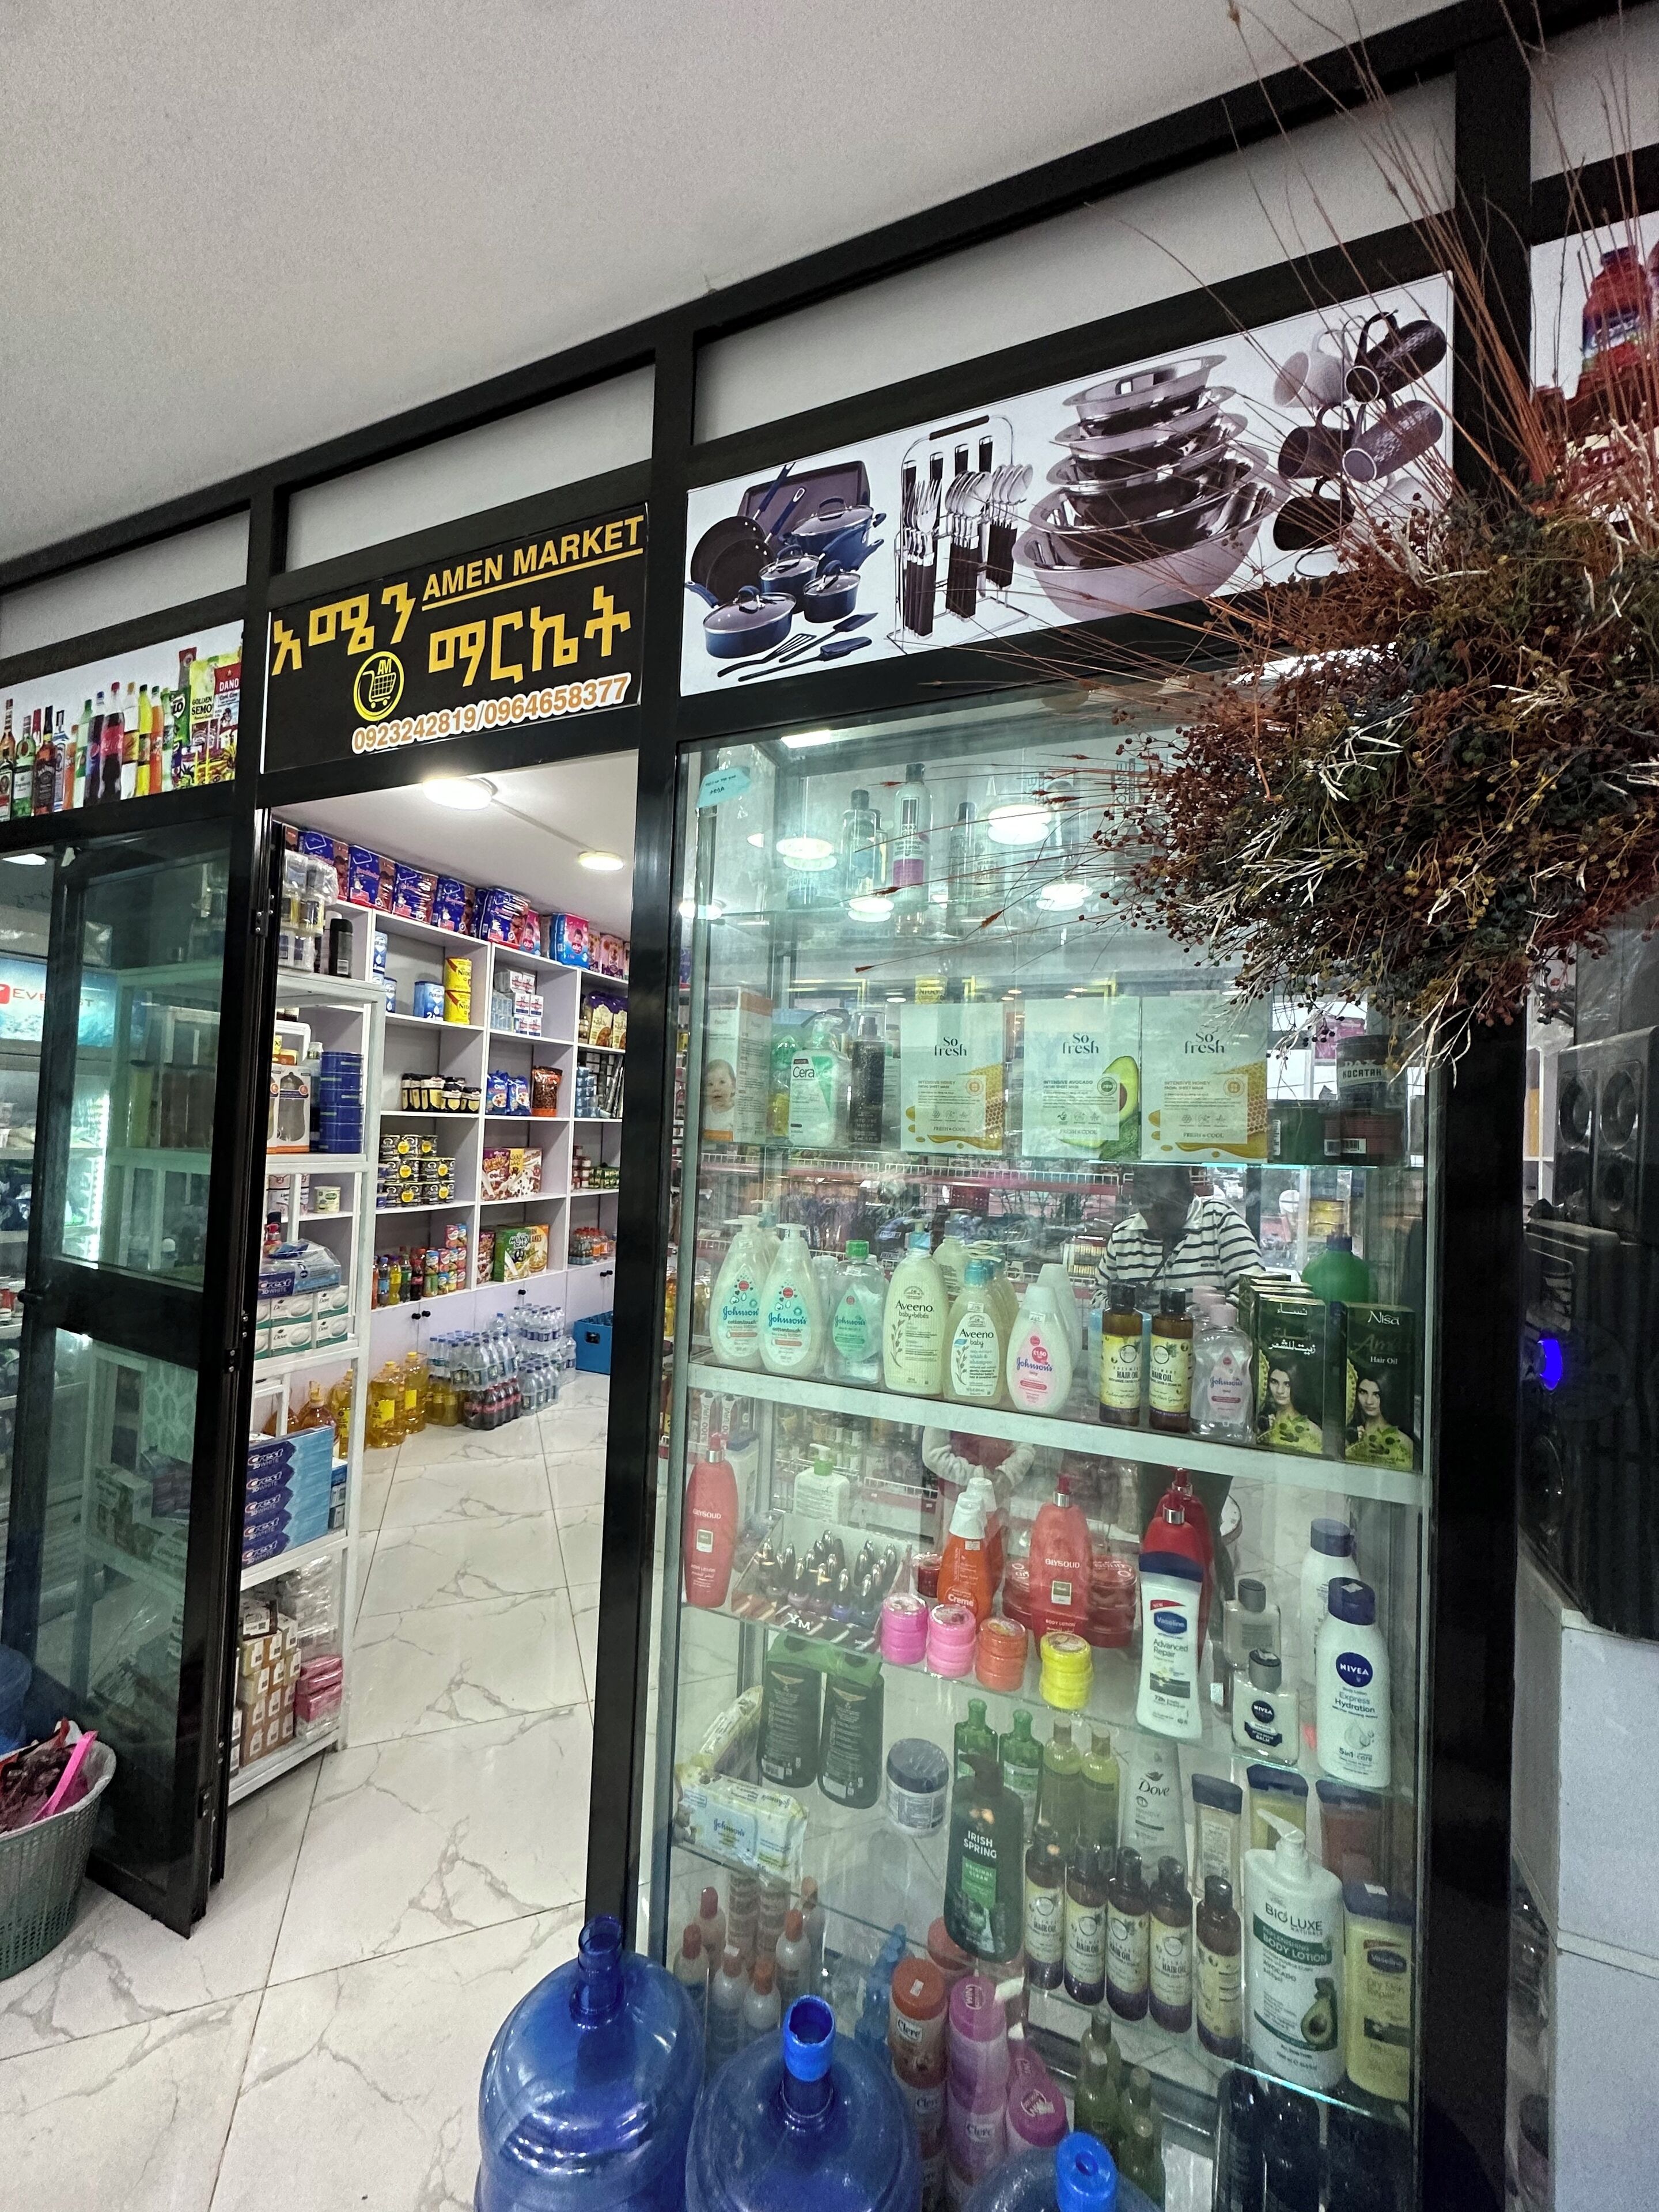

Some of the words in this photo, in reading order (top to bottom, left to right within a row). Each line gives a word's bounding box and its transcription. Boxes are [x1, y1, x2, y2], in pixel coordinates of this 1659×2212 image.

[423, 554, 503, 601] AMEN
[513, 515, 644, 576] MARKET
[428, 585, 631, 688] ማርኬት
[219, 677, 239, 692] DANO
[191, 696, 213, 705] GOLDEN
[191, 703, 214, 715] SEMO
[354, 675, 628, 751] 0923242819/0964658377
[943, 1036, 958, 1047] So
[1073, 1033, 1089, 1044] So
[1195, 1032, 1214, 1043] So
[934, 1044, 967, 1056] fresh
[1062, 1040, 1099, 1054] fresh
[1184, 1040, 1225, 1054] fresh
[895, 1300, 934, 1312] Aveeno
[768, 1312, 807, 1327] Johnson's
[959, 1328, 994, 1338] Aveeno
[970, 1339, 984, 1348] baby
[1297, 1344, 1316, 1355] زيت
[1016, 1357, 1054, 1372] Johnson's
[1370, 1356, 1385, 1364] Hair
[1045, 1558, 1081, 1569] GLYSOLID
[948, 1593, 975, 1607] Creme
[788, 1612, 810, 1631] YM
[1157, 1615, 1185, 1628] Vaseline
[1153, 1638, 1189, 1653] Advanced
[1153, 1645, 1176, 1658] Repair
[1340, 1662, 1370, 1676] NIVEA
[1339, 1691, 1370, 1705] Express
[1254, 1705, 1272, 1715] NIVEA
[1335, 1698, 1376, 1714] Hydration
[1138, 1778, 1170, 1797] Dove
[968, 1830, 993, 1848] IRISH
[963, 1838, 997, 1859] SPRING
[1263, 1933, 1289, 1954] BODY
[1292, 1949, 1327, 1962] LOTION
